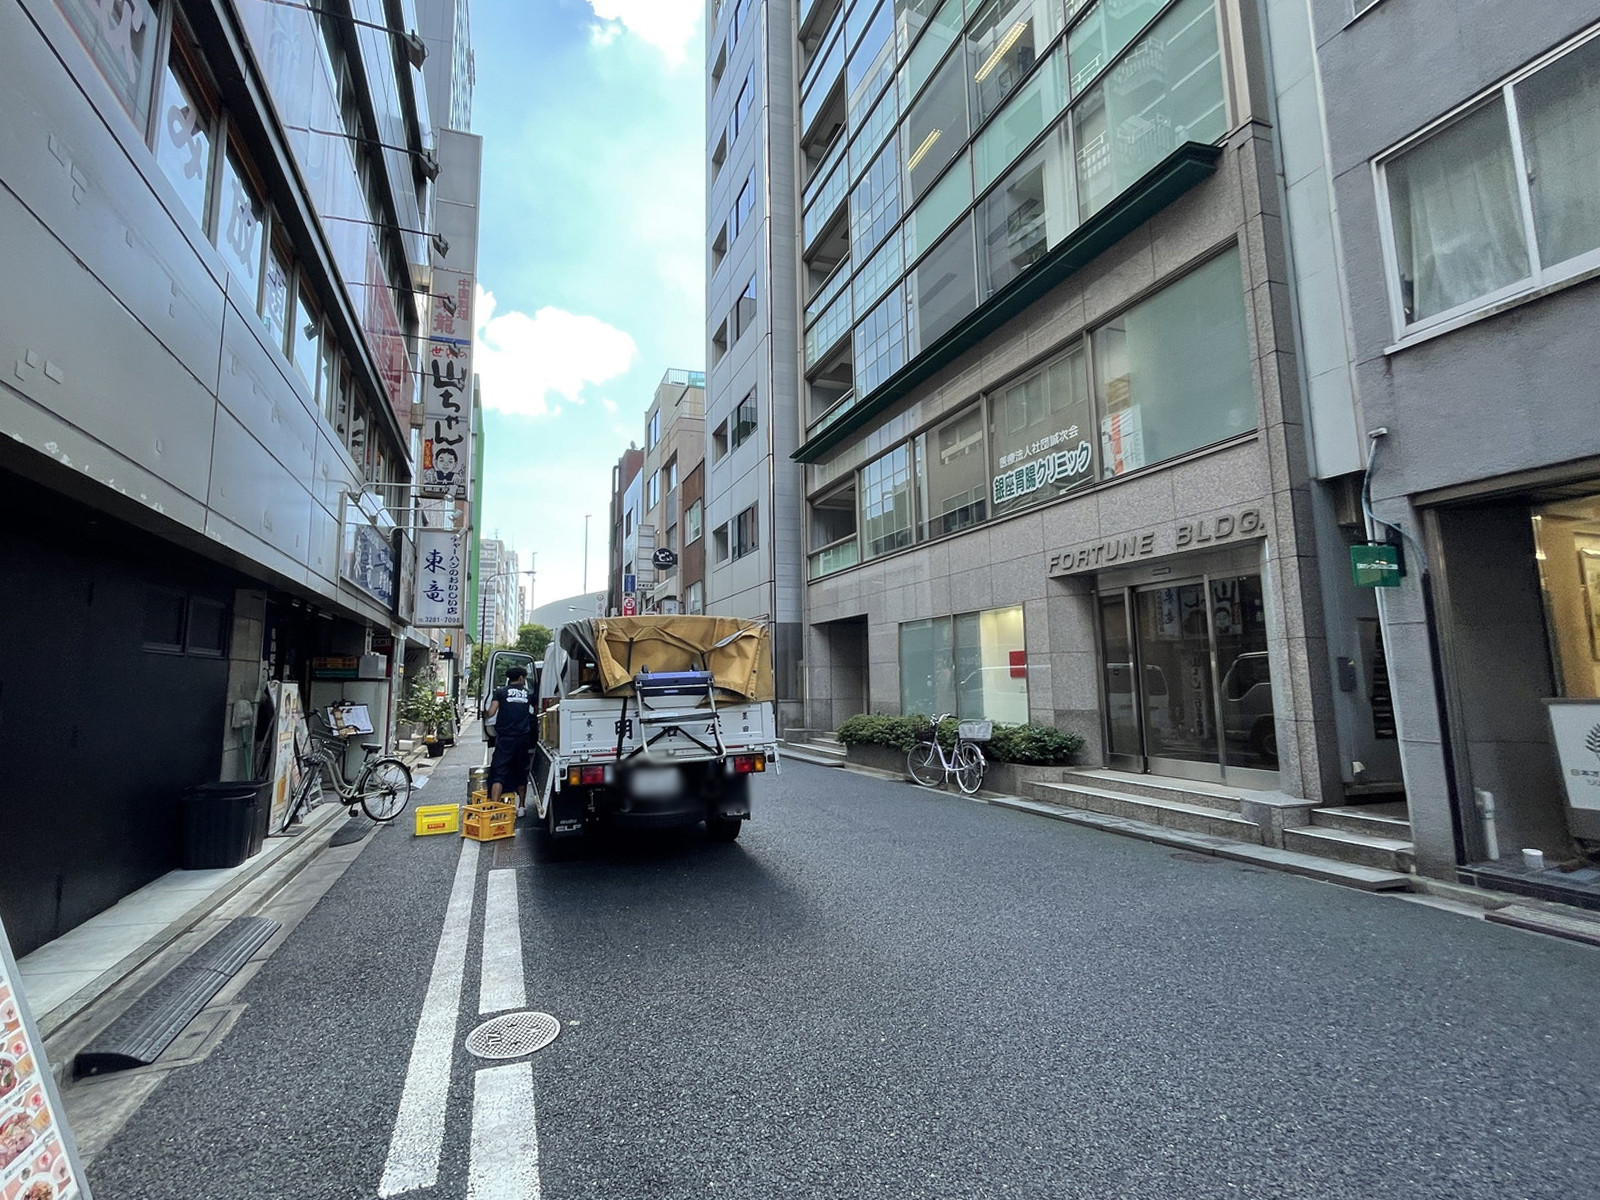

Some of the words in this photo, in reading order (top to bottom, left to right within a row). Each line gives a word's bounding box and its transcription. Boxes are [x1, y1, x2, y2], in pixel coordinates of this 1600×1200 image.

[431, 359, 467, 446] 山ちゃん
[994, 441, 1091, 503] 銀座胃腸クリニック
[1049, 532, 1155, 573] FORTUNE
[1177, 509, 1265, 547] BLDG.
[423, 549, 446, 602] 東竜
[556, 824, 581, 832] ELF
